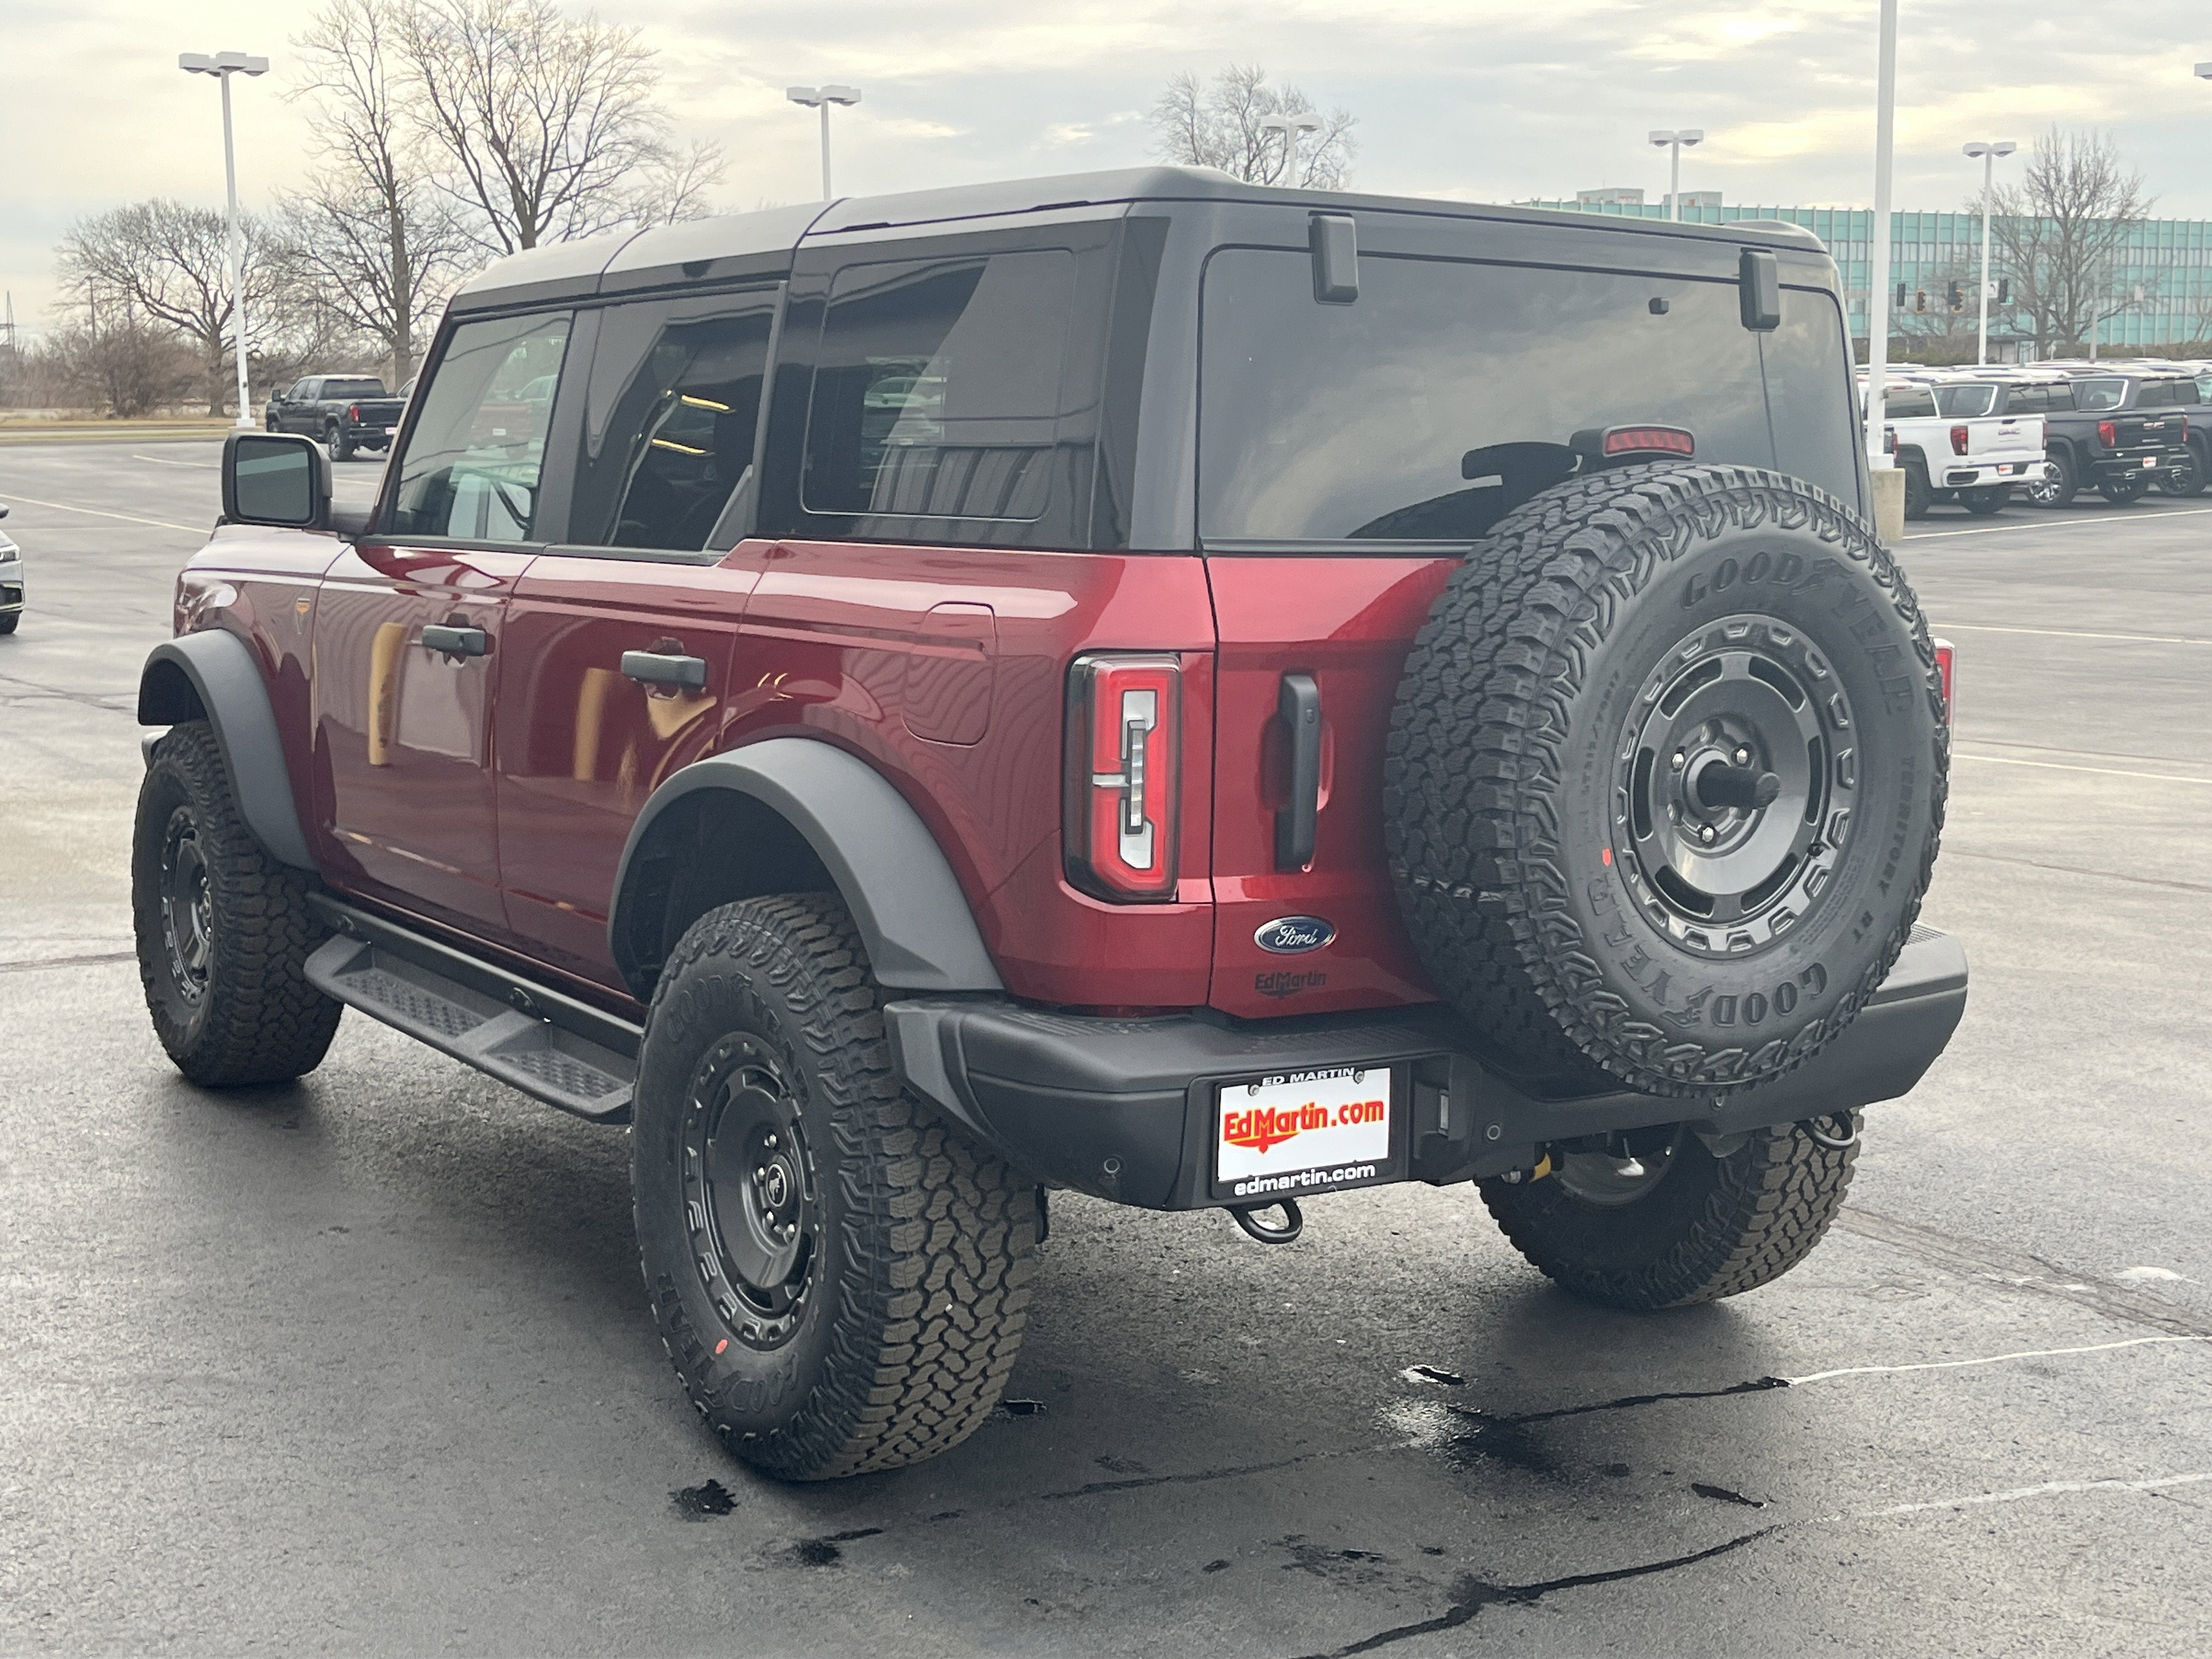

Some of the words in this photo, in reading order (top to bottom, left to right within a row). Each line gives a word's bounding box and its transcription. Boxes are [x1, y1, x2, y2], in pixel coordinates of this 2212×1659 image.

[1275, 925, 1318, 947] Ford
[1255, 970, 1327, 992] EdMartin
[1262, 1076, 1285, 1087] ED
[1289, 1067, 1355, 1084] MARTIN
[1234, 1164, 1375, 1196] edmartin.com
